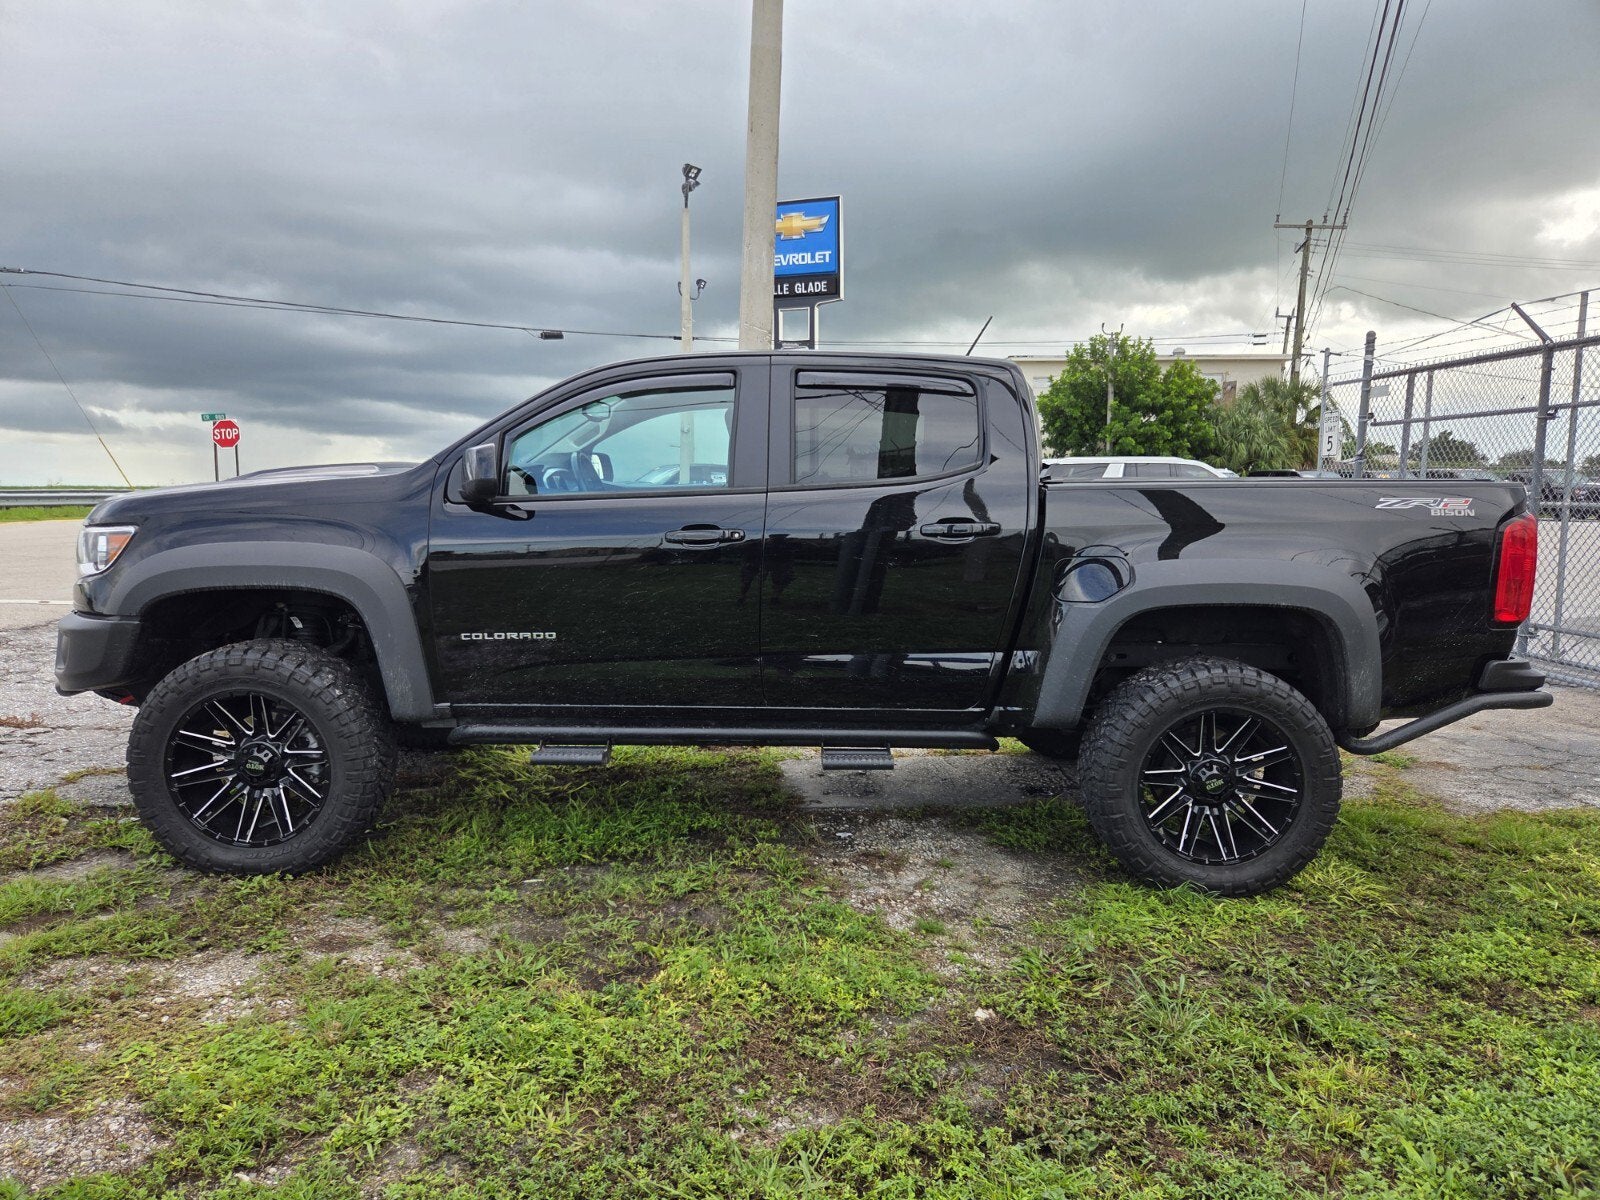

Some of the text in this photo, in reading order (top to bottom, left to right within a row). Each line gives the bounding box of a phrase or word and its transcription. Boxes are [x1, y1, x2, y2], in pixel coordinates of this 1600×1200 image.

[774, 250, 832, 266] EVROLET
[794, 281, 828, 294] GLADE
[1324, 416, 1339, 424] SPEED
[213, 428, 239, 440] STOP
[1326, 435, 1333, 452] 5
[1430, 508, 1475, 517] BISON
[460, 631, 557, 641] COLORADO
